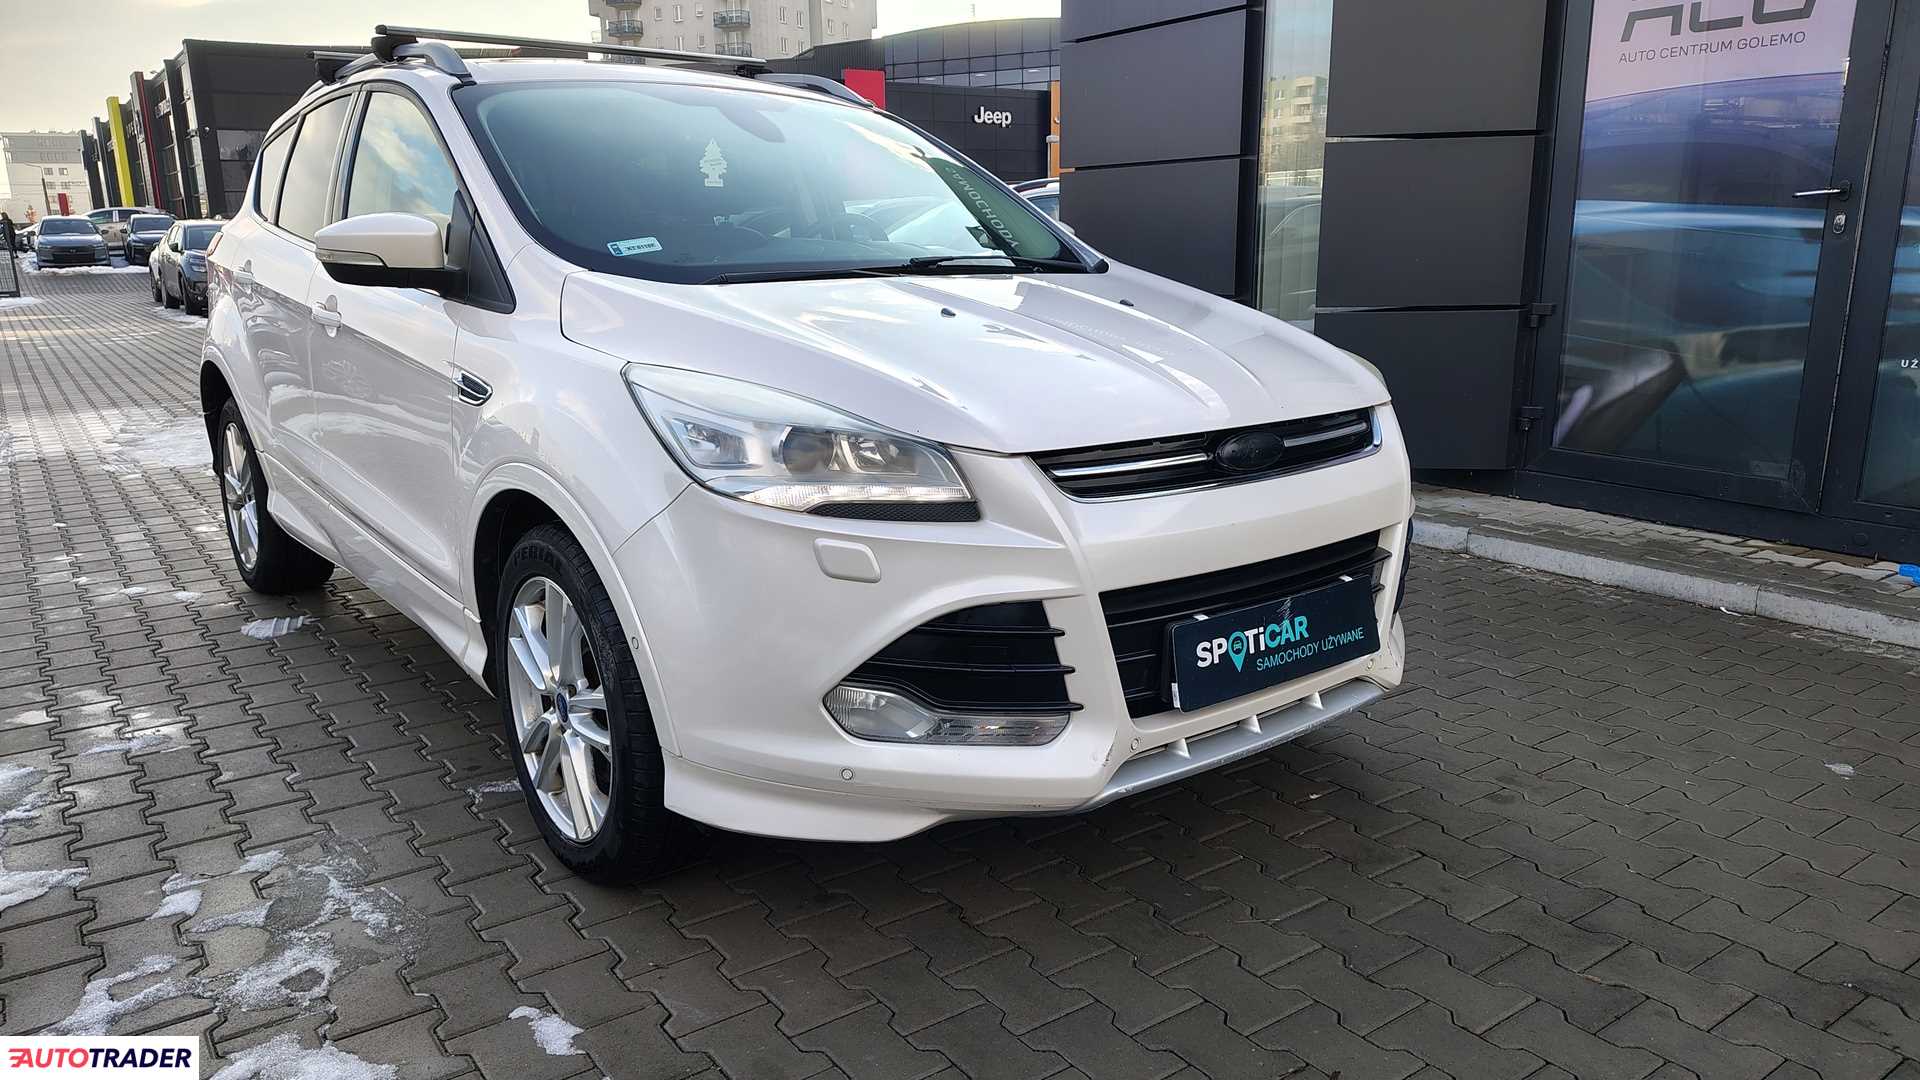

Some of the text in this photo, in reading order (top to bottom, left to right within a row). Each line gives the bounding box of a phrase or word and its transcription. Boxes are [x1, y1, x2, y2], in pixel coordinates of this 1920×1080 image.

[1618, 31, 1806, 64] AUTO CENTRUM GOLEMO
[974, 106, 1011, 128] Jeep
[944, 166, 1020, 247] AMOCHODY
[1256, 626, 1365, 672] SAMOCHODY UŻYWANE
